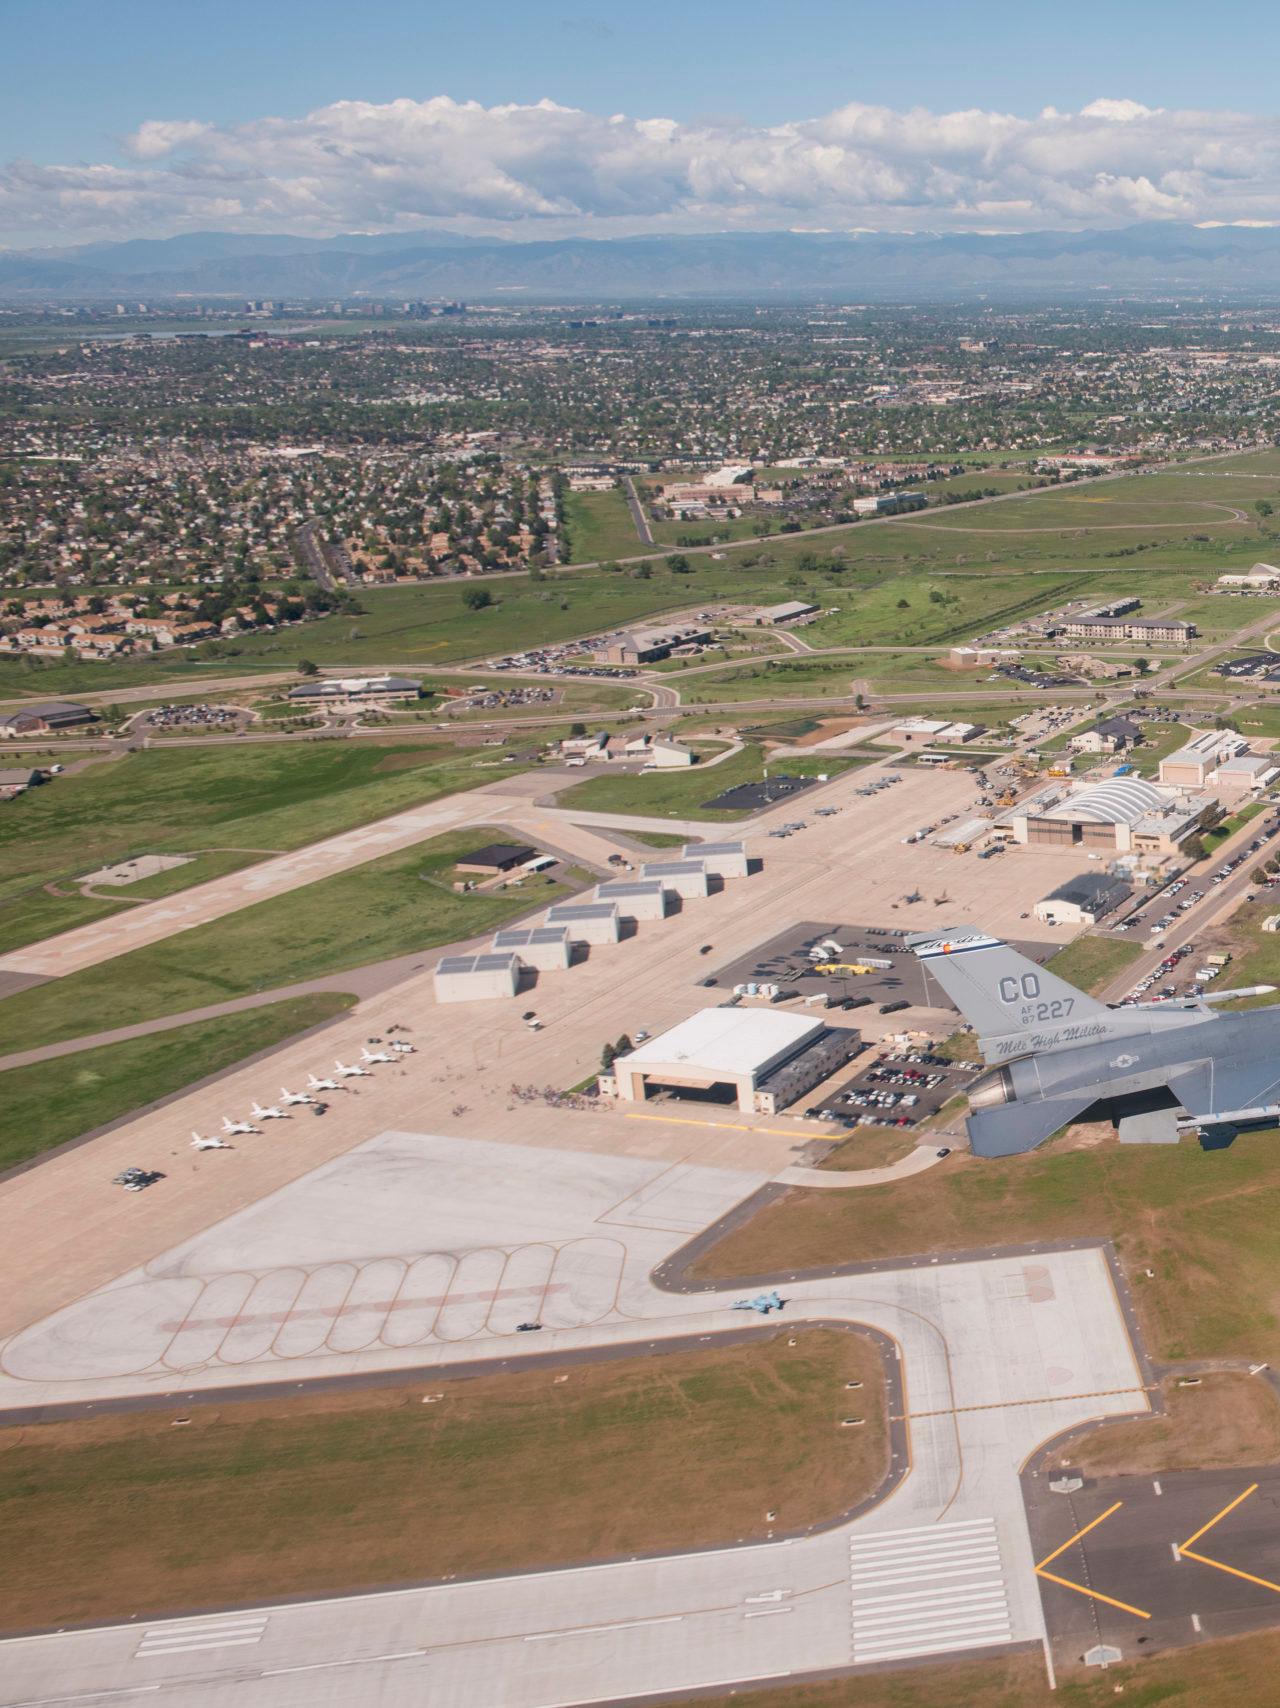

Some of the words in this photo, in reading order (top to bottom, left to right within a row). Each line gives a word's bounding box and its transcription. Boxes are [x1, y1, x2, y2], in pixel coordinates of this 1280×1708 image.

[999, 972, 1041, 1003] CO
[1021, 1005, 1033, 1014] AF
[1022, 1015, 1035, 1024] 87
[1036, 998, 1076, 1021] 227
[996, 1040, 1027, 1054] Mile
[1030, 1033, 1062, 1049] High
[1063, 1024, 1108, 1041] Militia
